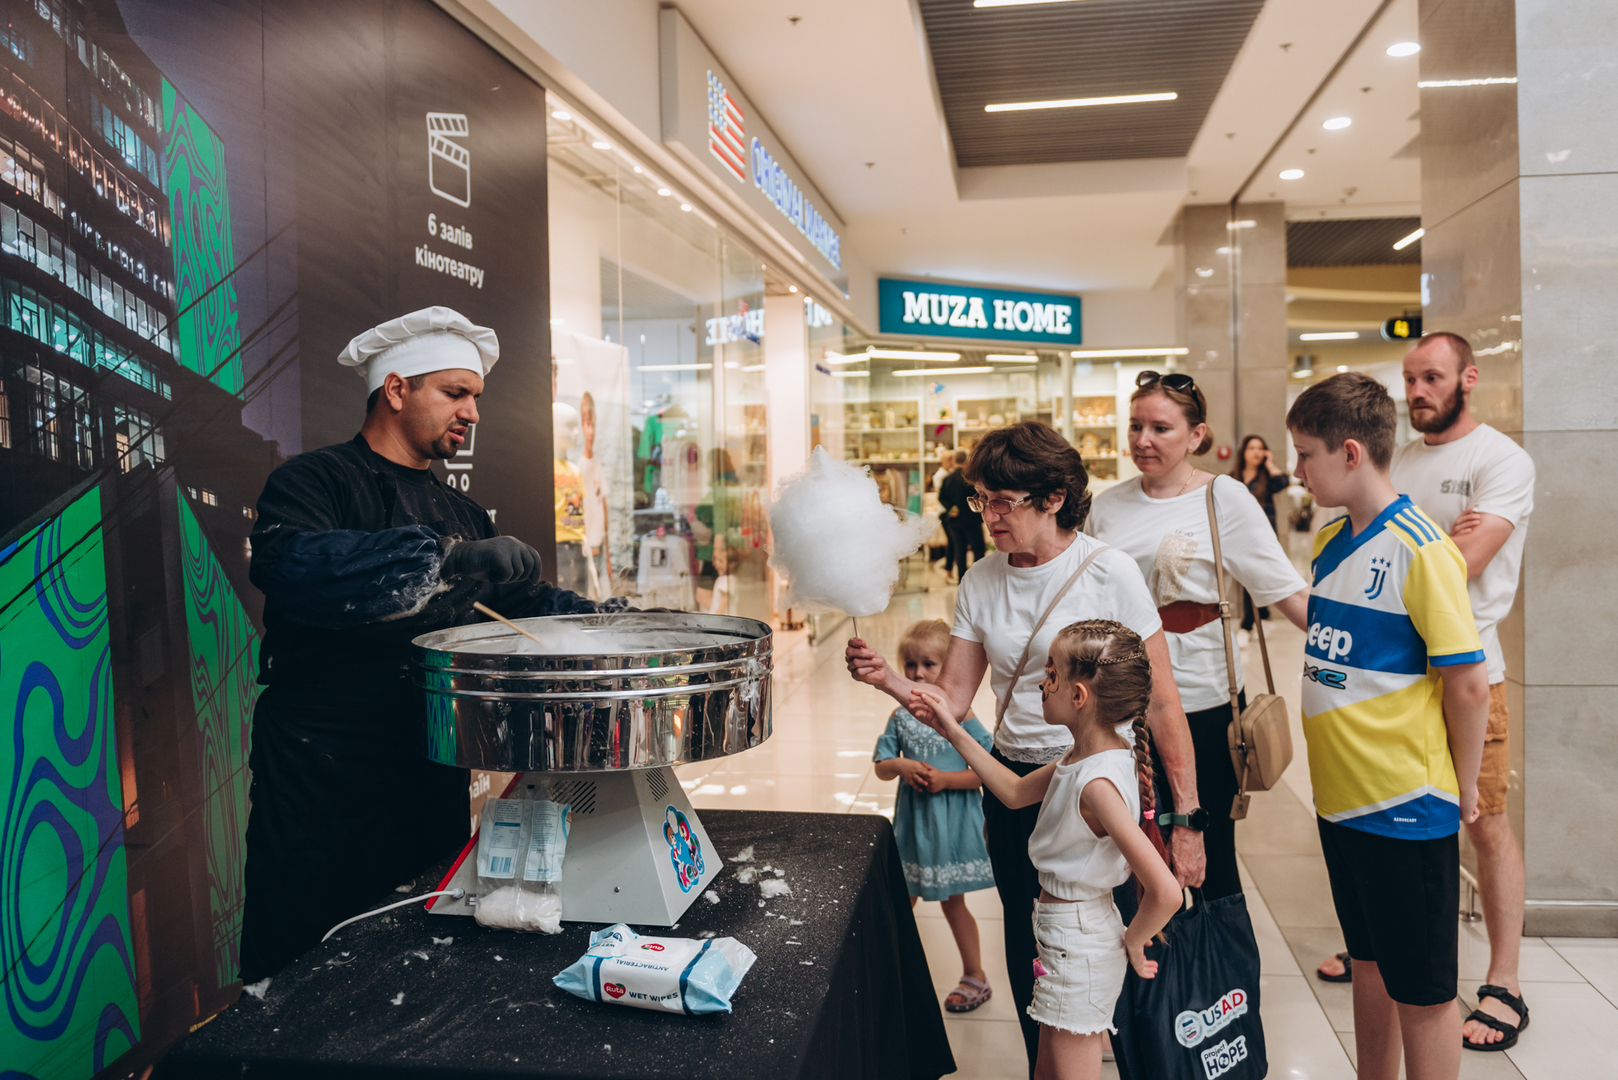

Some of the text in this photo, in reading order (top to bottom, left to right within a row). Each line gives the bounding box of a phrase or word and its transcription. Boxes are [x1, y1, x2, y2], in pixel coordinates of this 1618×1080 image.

[428, 212, 473, 250] 6 залів
[415, 244, 485, 289] кінотеатру
[902, 291, 1072, 335] MUZA HOME
[1308, 621, 1353, 661] eep
[615, 959, 669, 972] ANTIBACTERIAL
[606, 986, 624, 994] Ruta
[629, 991, 647, 1001] WET
[649, 991, 679, 1003] WIPES
[1202, 992, 1244, 1026] USAD
[1204, 1043, 1226, 1061] project
[1206, 1040, 1245, 1076] HOPE
